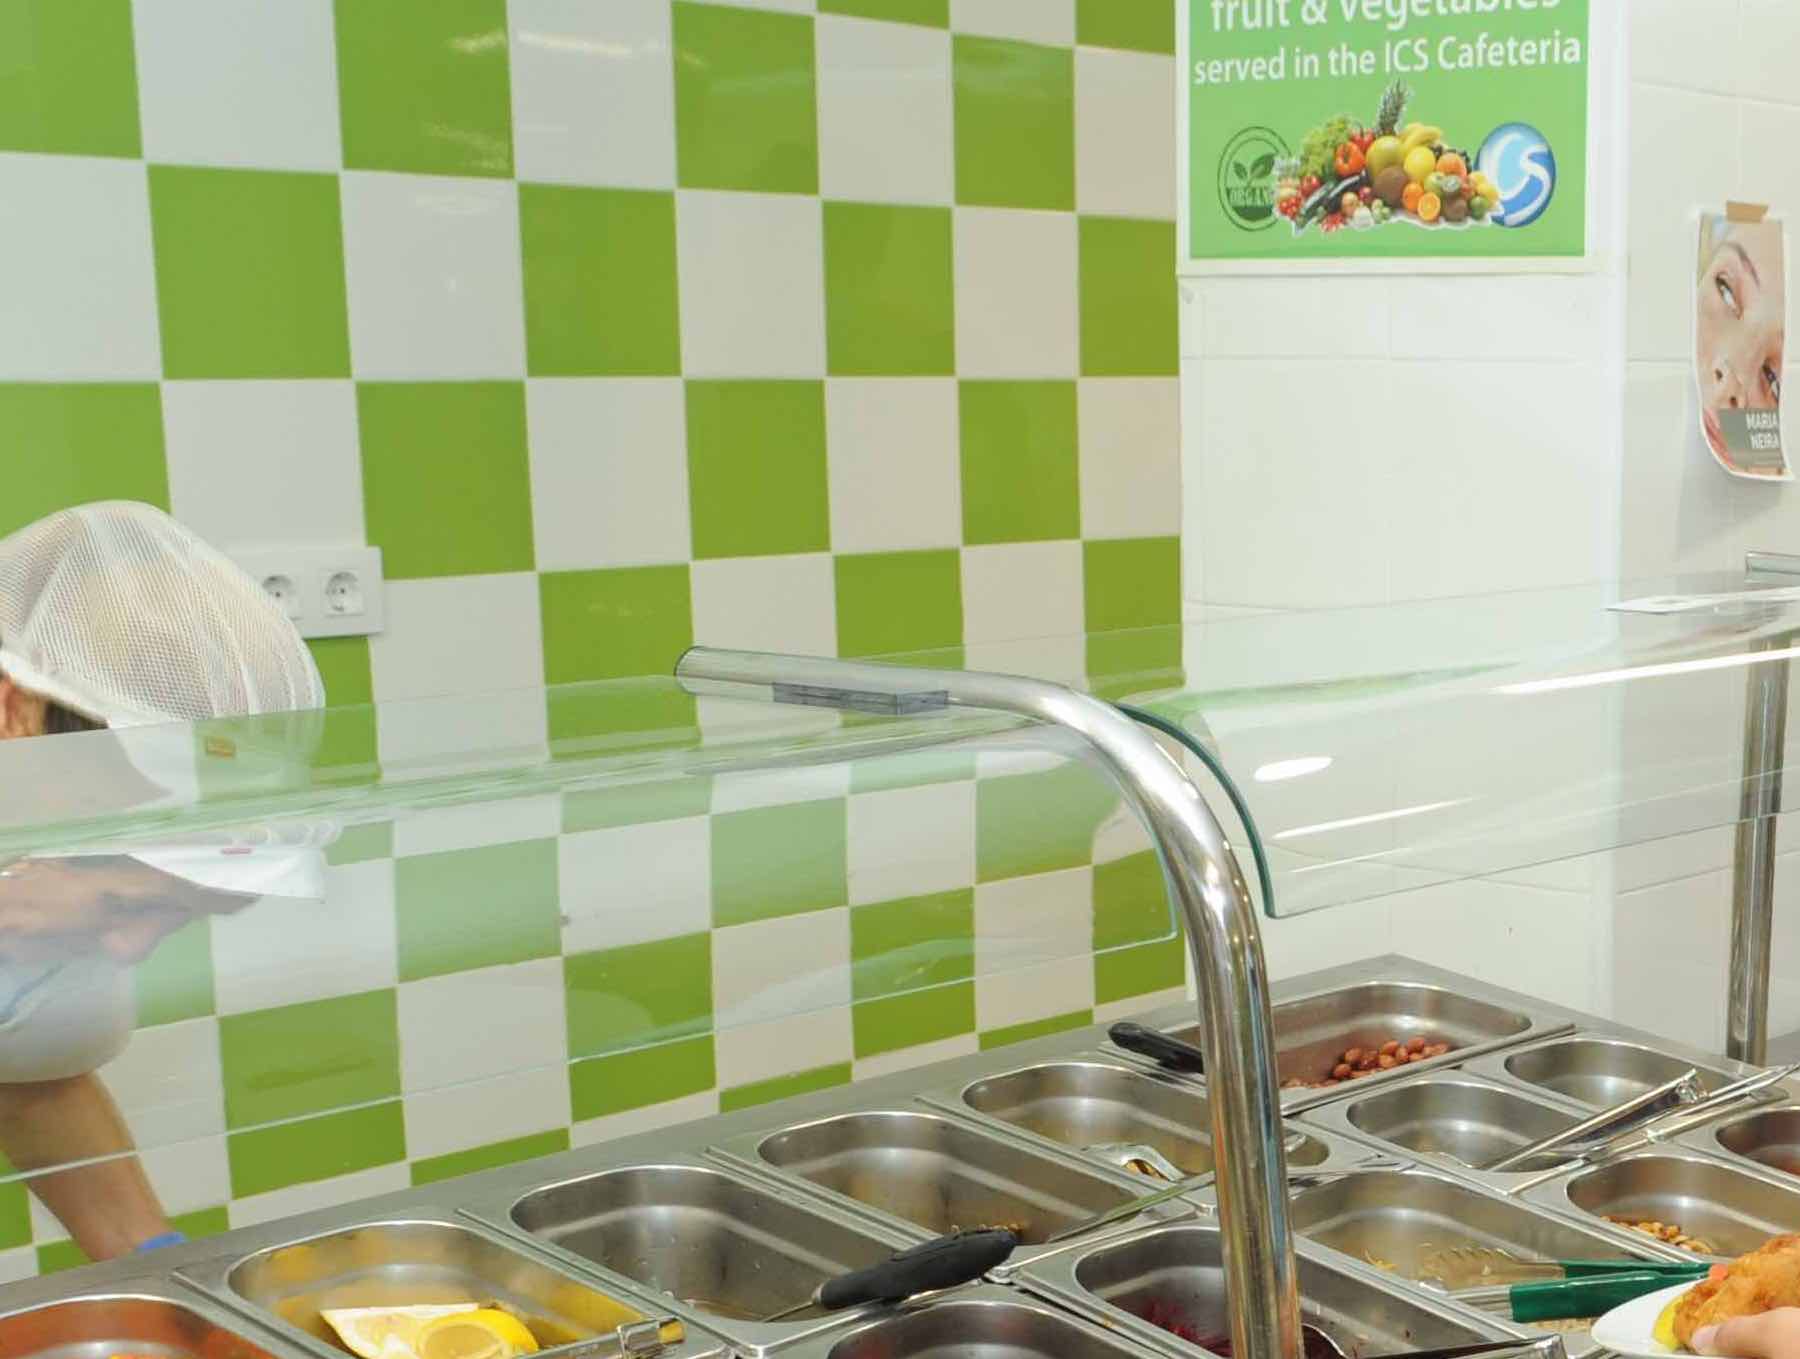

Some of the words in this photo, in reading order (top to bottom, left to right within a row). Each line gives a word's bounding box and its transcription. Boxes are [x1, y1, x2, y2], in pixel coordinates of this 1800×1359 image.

[1211, 0, 1290, 32] fruit
[1301, 0, 1328, 25] &
[1341, 0, 1560, 30] vegea
[1194, 48, 1285, 85] served
[1295, 48, 1320, 78] in
[1328, 44, 1375, 75] the
[1384, 38, 1429, 73] ICS
[1437, 30, 1581, 70] Cafeteria
